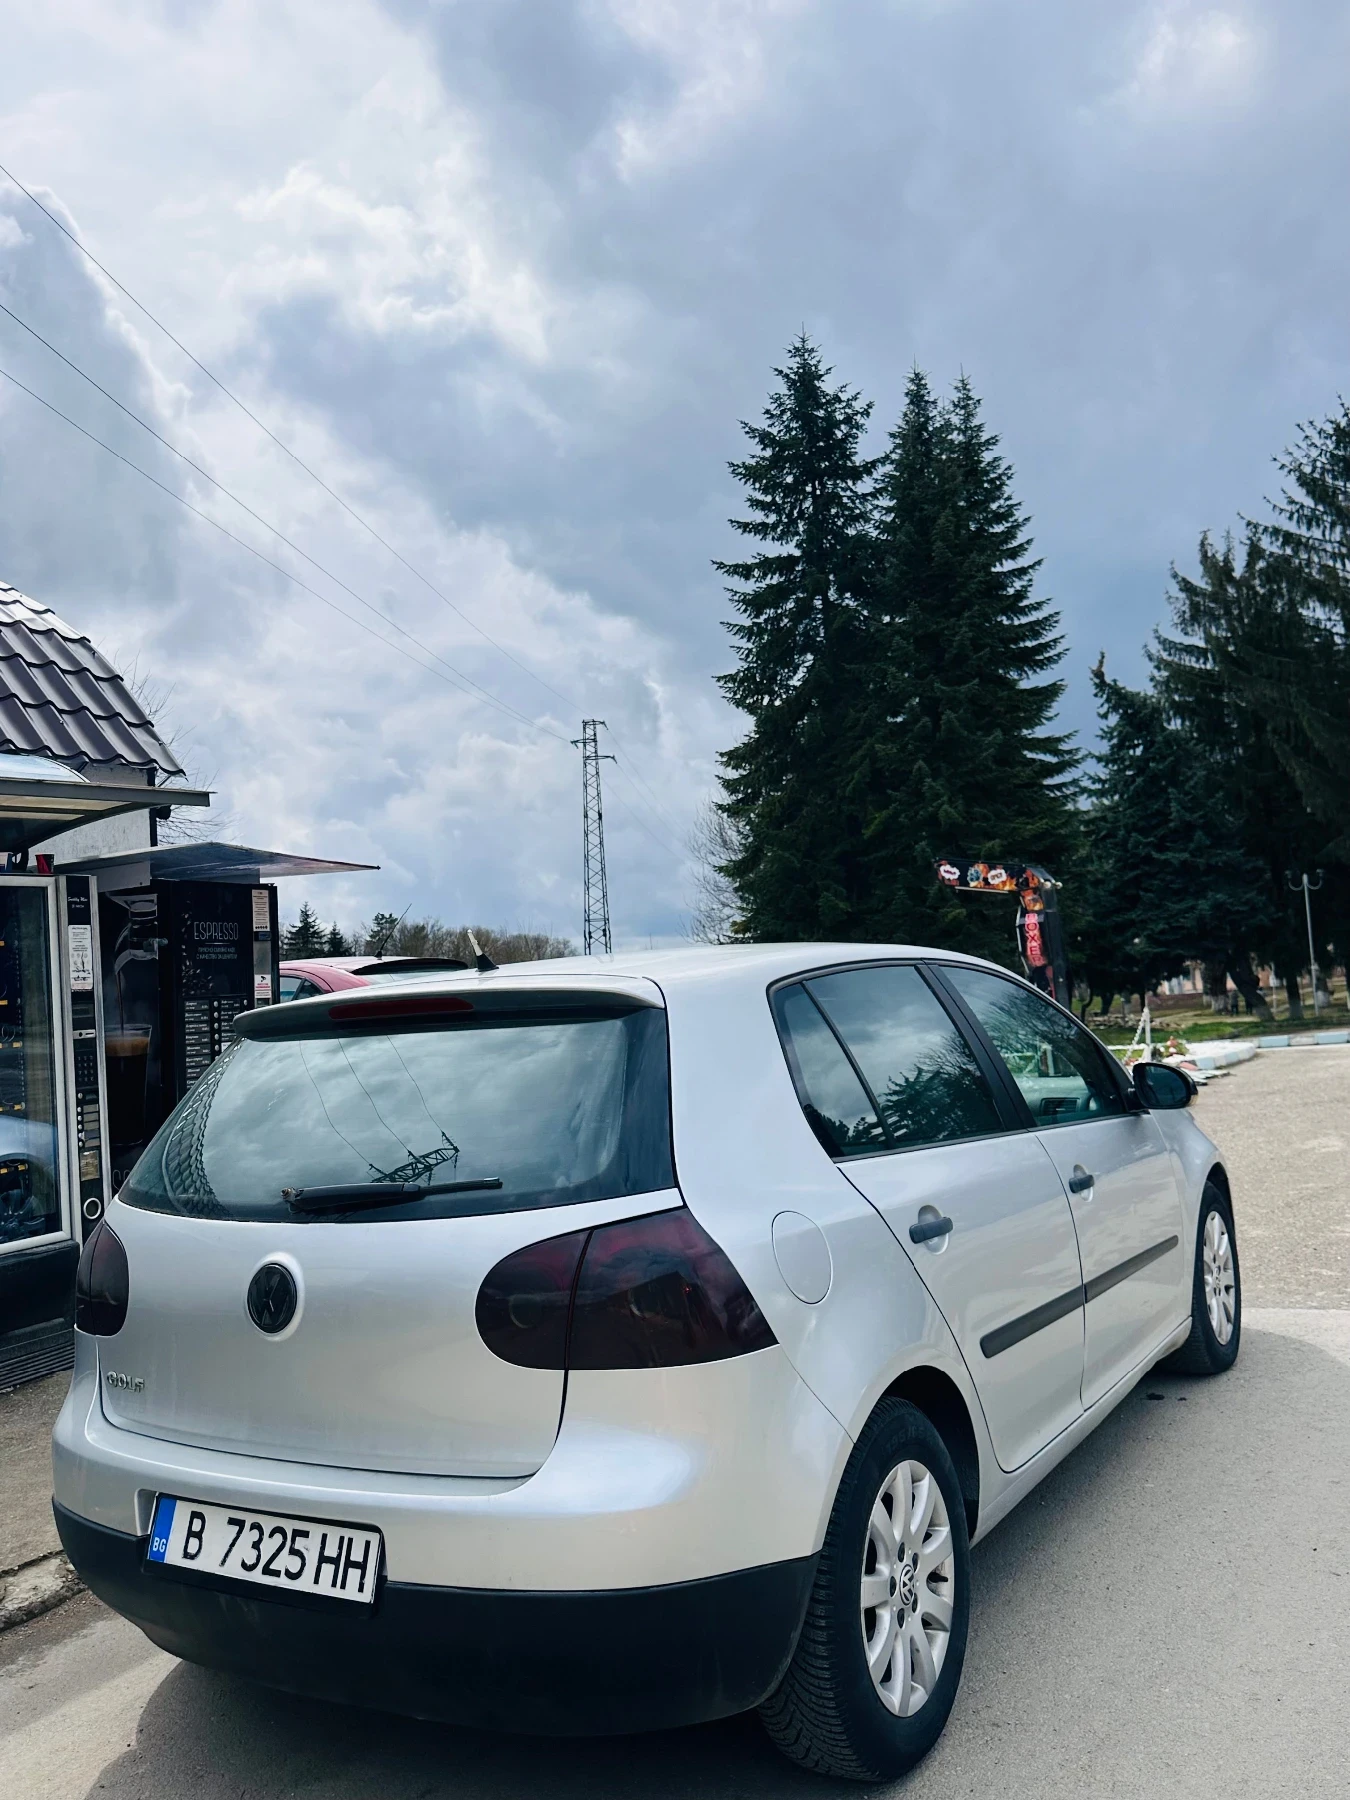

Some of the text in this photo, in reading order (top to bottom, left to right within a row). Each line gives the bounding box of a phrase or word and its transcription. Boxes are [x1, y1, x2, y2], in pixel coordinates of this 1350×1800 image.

[194, 921, 239, 940] ESPRESSO
[107, 1371, 144, 1392] GOLF
[152, 1536, 167, 1553] BG
[182, 1510, 371, 1593] B 7325 HH
